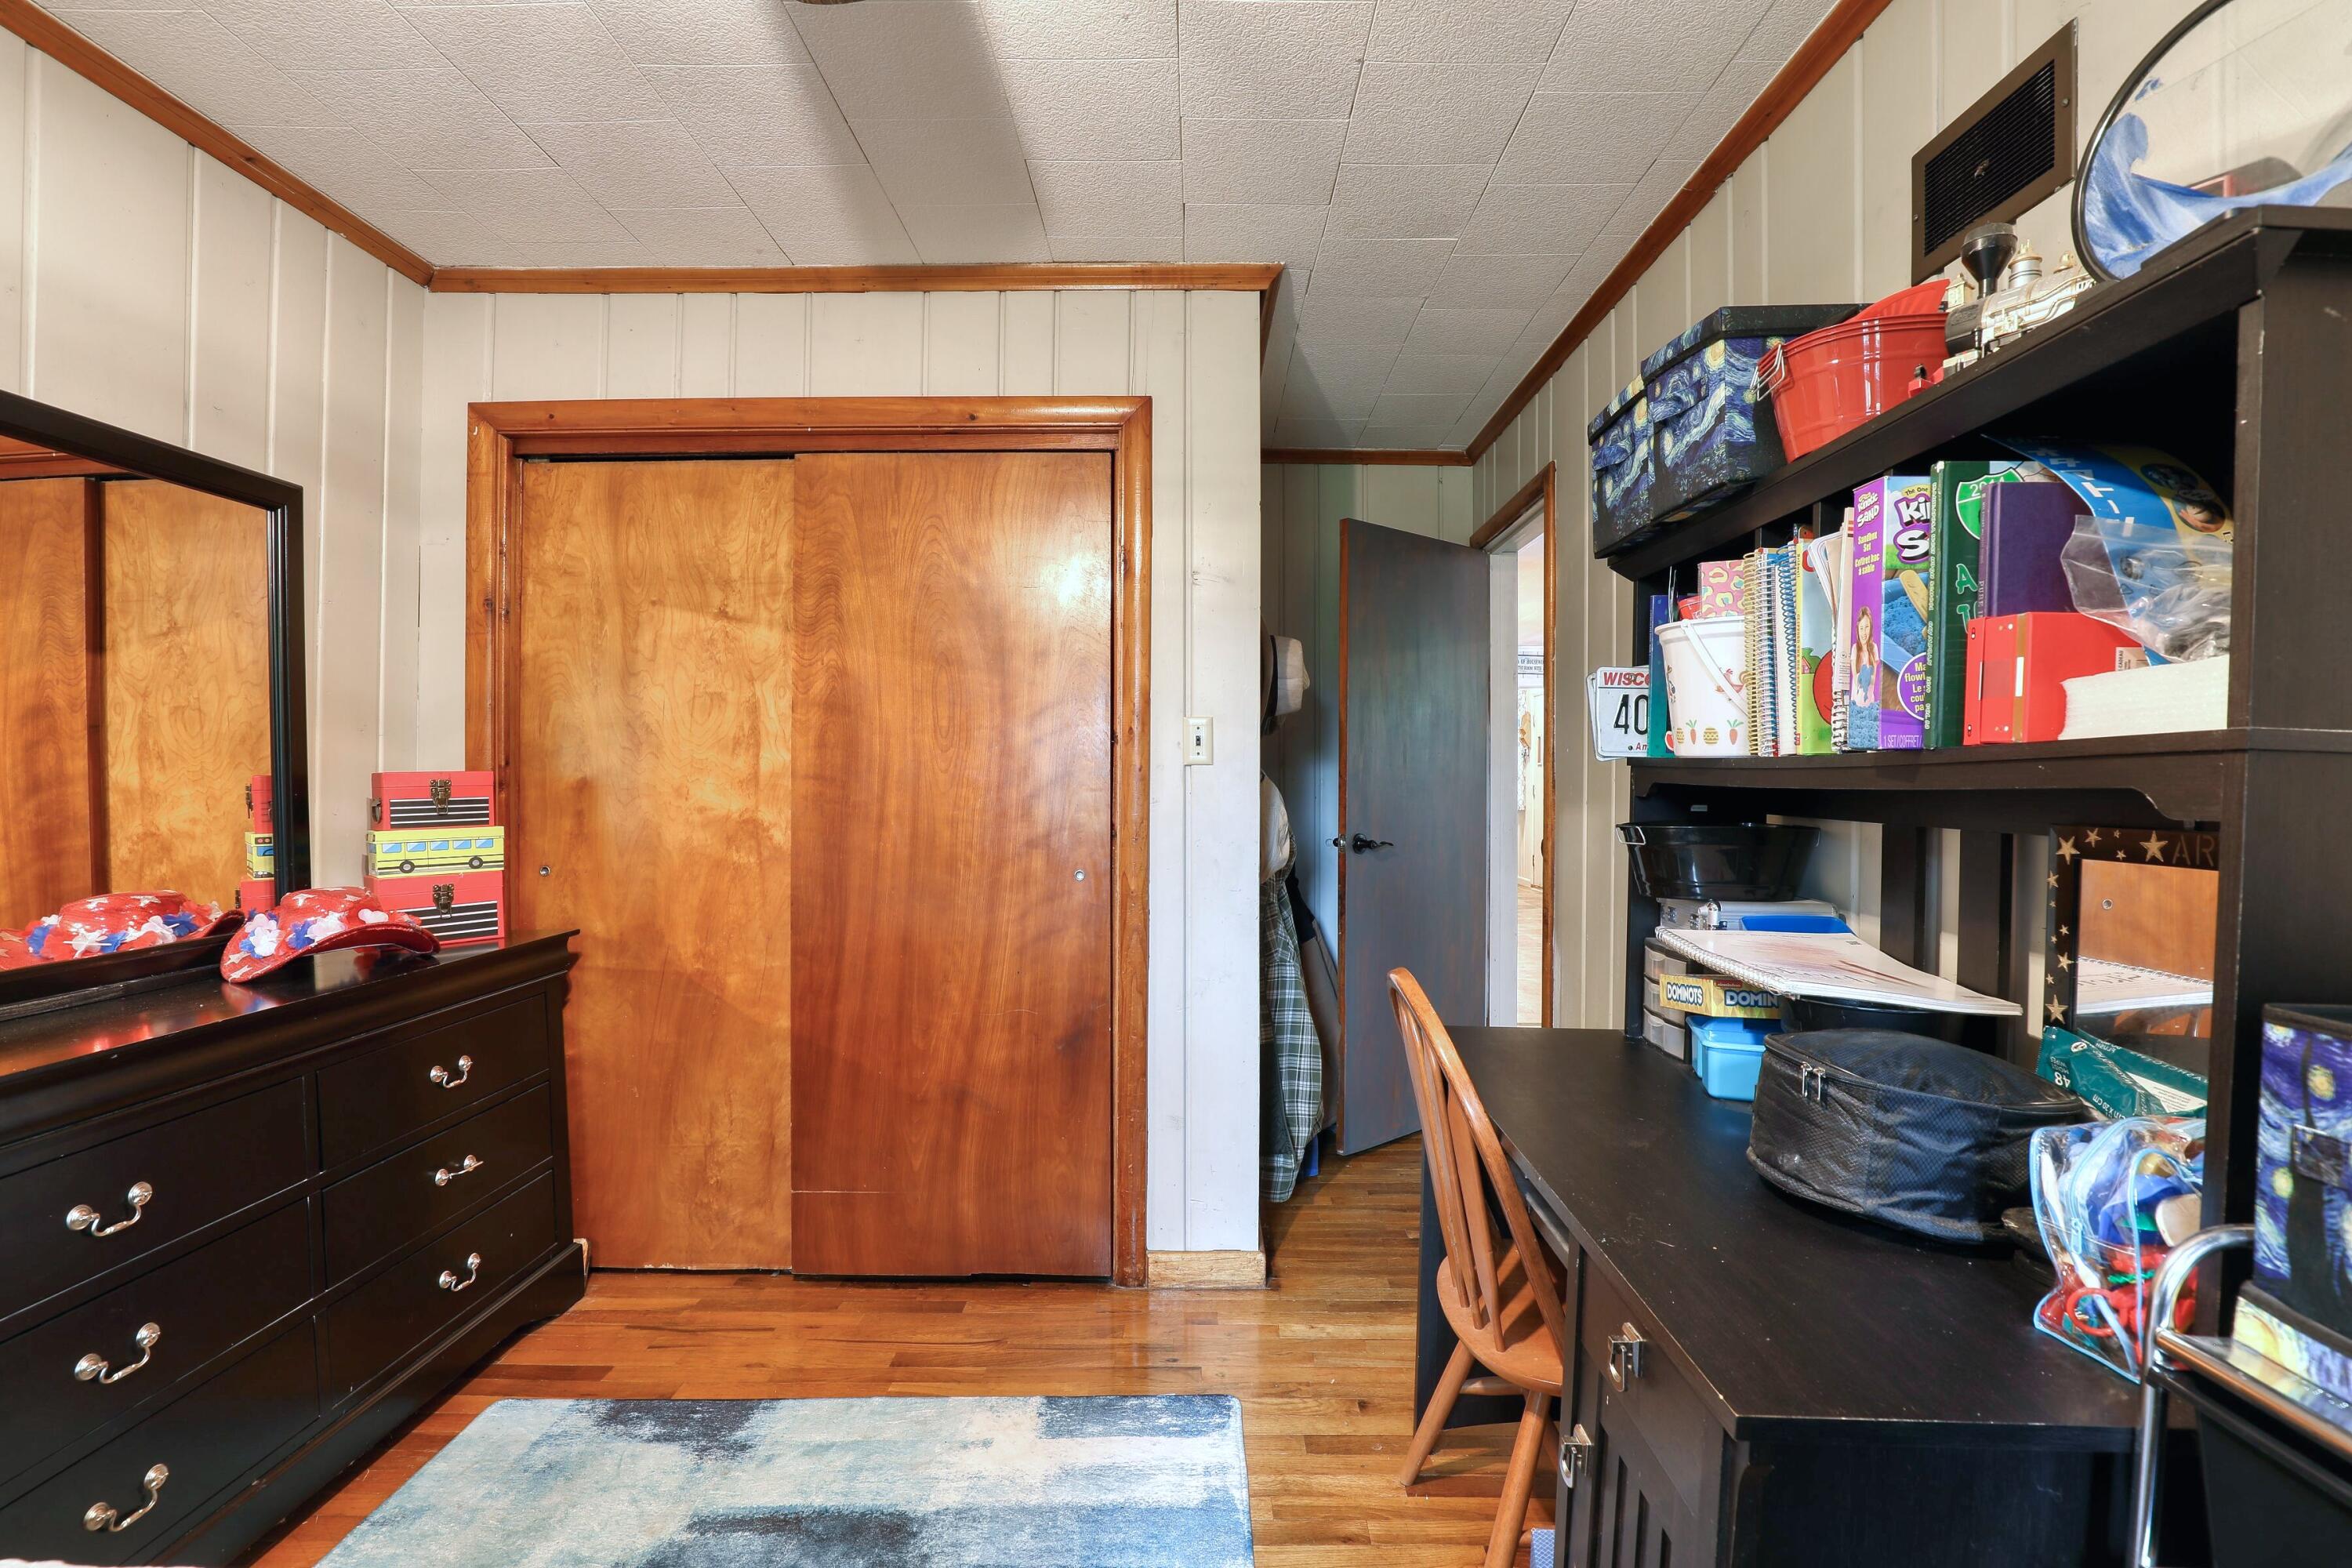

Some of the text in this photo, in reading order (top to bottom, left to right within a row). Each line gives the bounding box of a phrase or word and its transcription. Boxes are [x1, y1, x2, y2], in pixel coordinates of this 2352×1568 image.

[1858, 532, 1878, 544] Sandbox
[1863, 543, 1871, 552] Set
[1862, 564, 1875, 575] sable
[1913, 684, 1922, 693] Le
[1613, 694, 1648, 735] 40
[1666, 982, 1704, 1007] DOMINOTS
[1725, 990, 1779, 1007] DOMIN
[2050, 1056, 2067, 1068] WIPES
[2054, 1071, 2071, 1088] 48
[2092, 1094, 2103, 1105] cm
